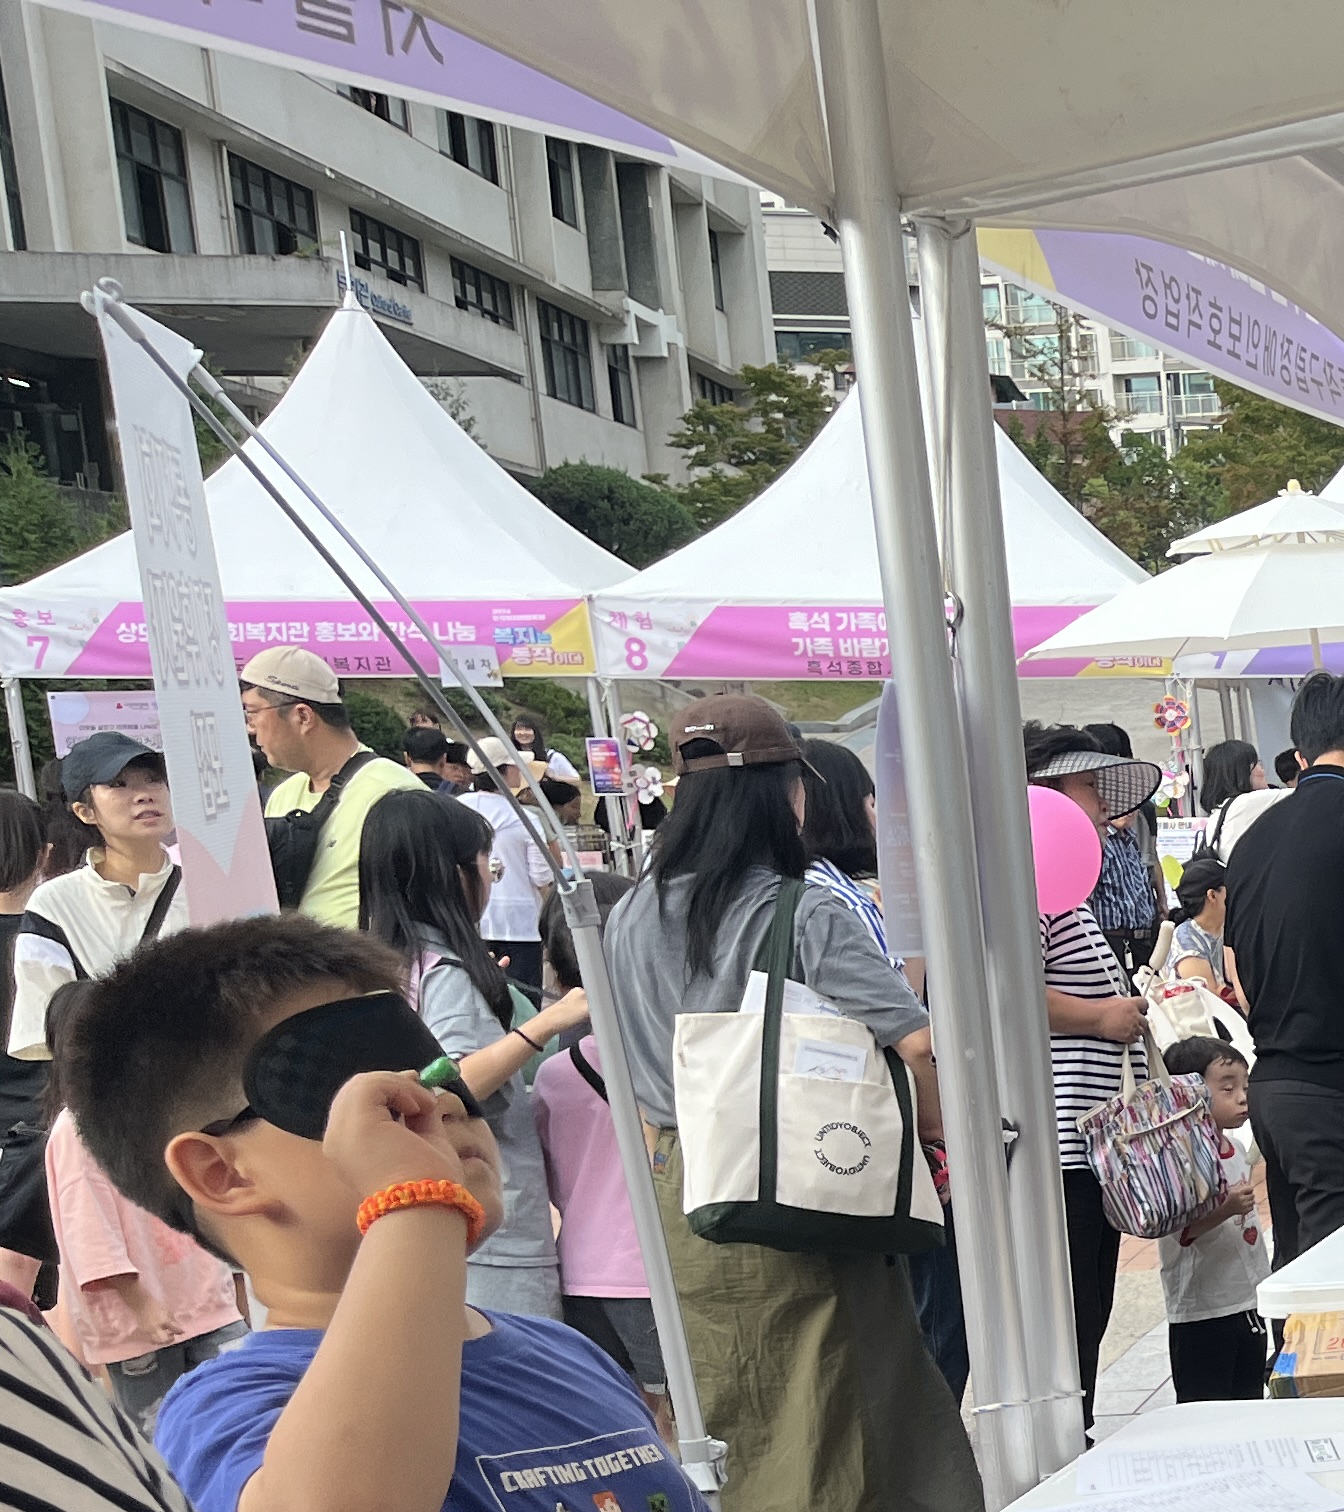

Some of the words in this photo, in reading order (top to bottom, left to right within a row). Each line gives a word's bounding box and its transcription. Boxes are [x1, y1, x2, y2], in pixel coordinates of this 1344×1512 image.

[314, 621, 380, 643] 홍보와
[433, 621, 477, 643] 나눔
[788, 612, 831, 632] 흑석
[26, 635, 50, 670] 7
[625, 637, 648, 671] 8
[793, 637, 835, 657] 가족
[807, 660, 891, 676] 흑석종합
[814, 1121, 872, 1147] UNTIDYOBJECT
[814, 1148, 870, 1175] UNTIDYOBJECT
[499, 1458, 588, 1493] CRAFTING
[583, 1443, 665, 1481] TOGETHER
